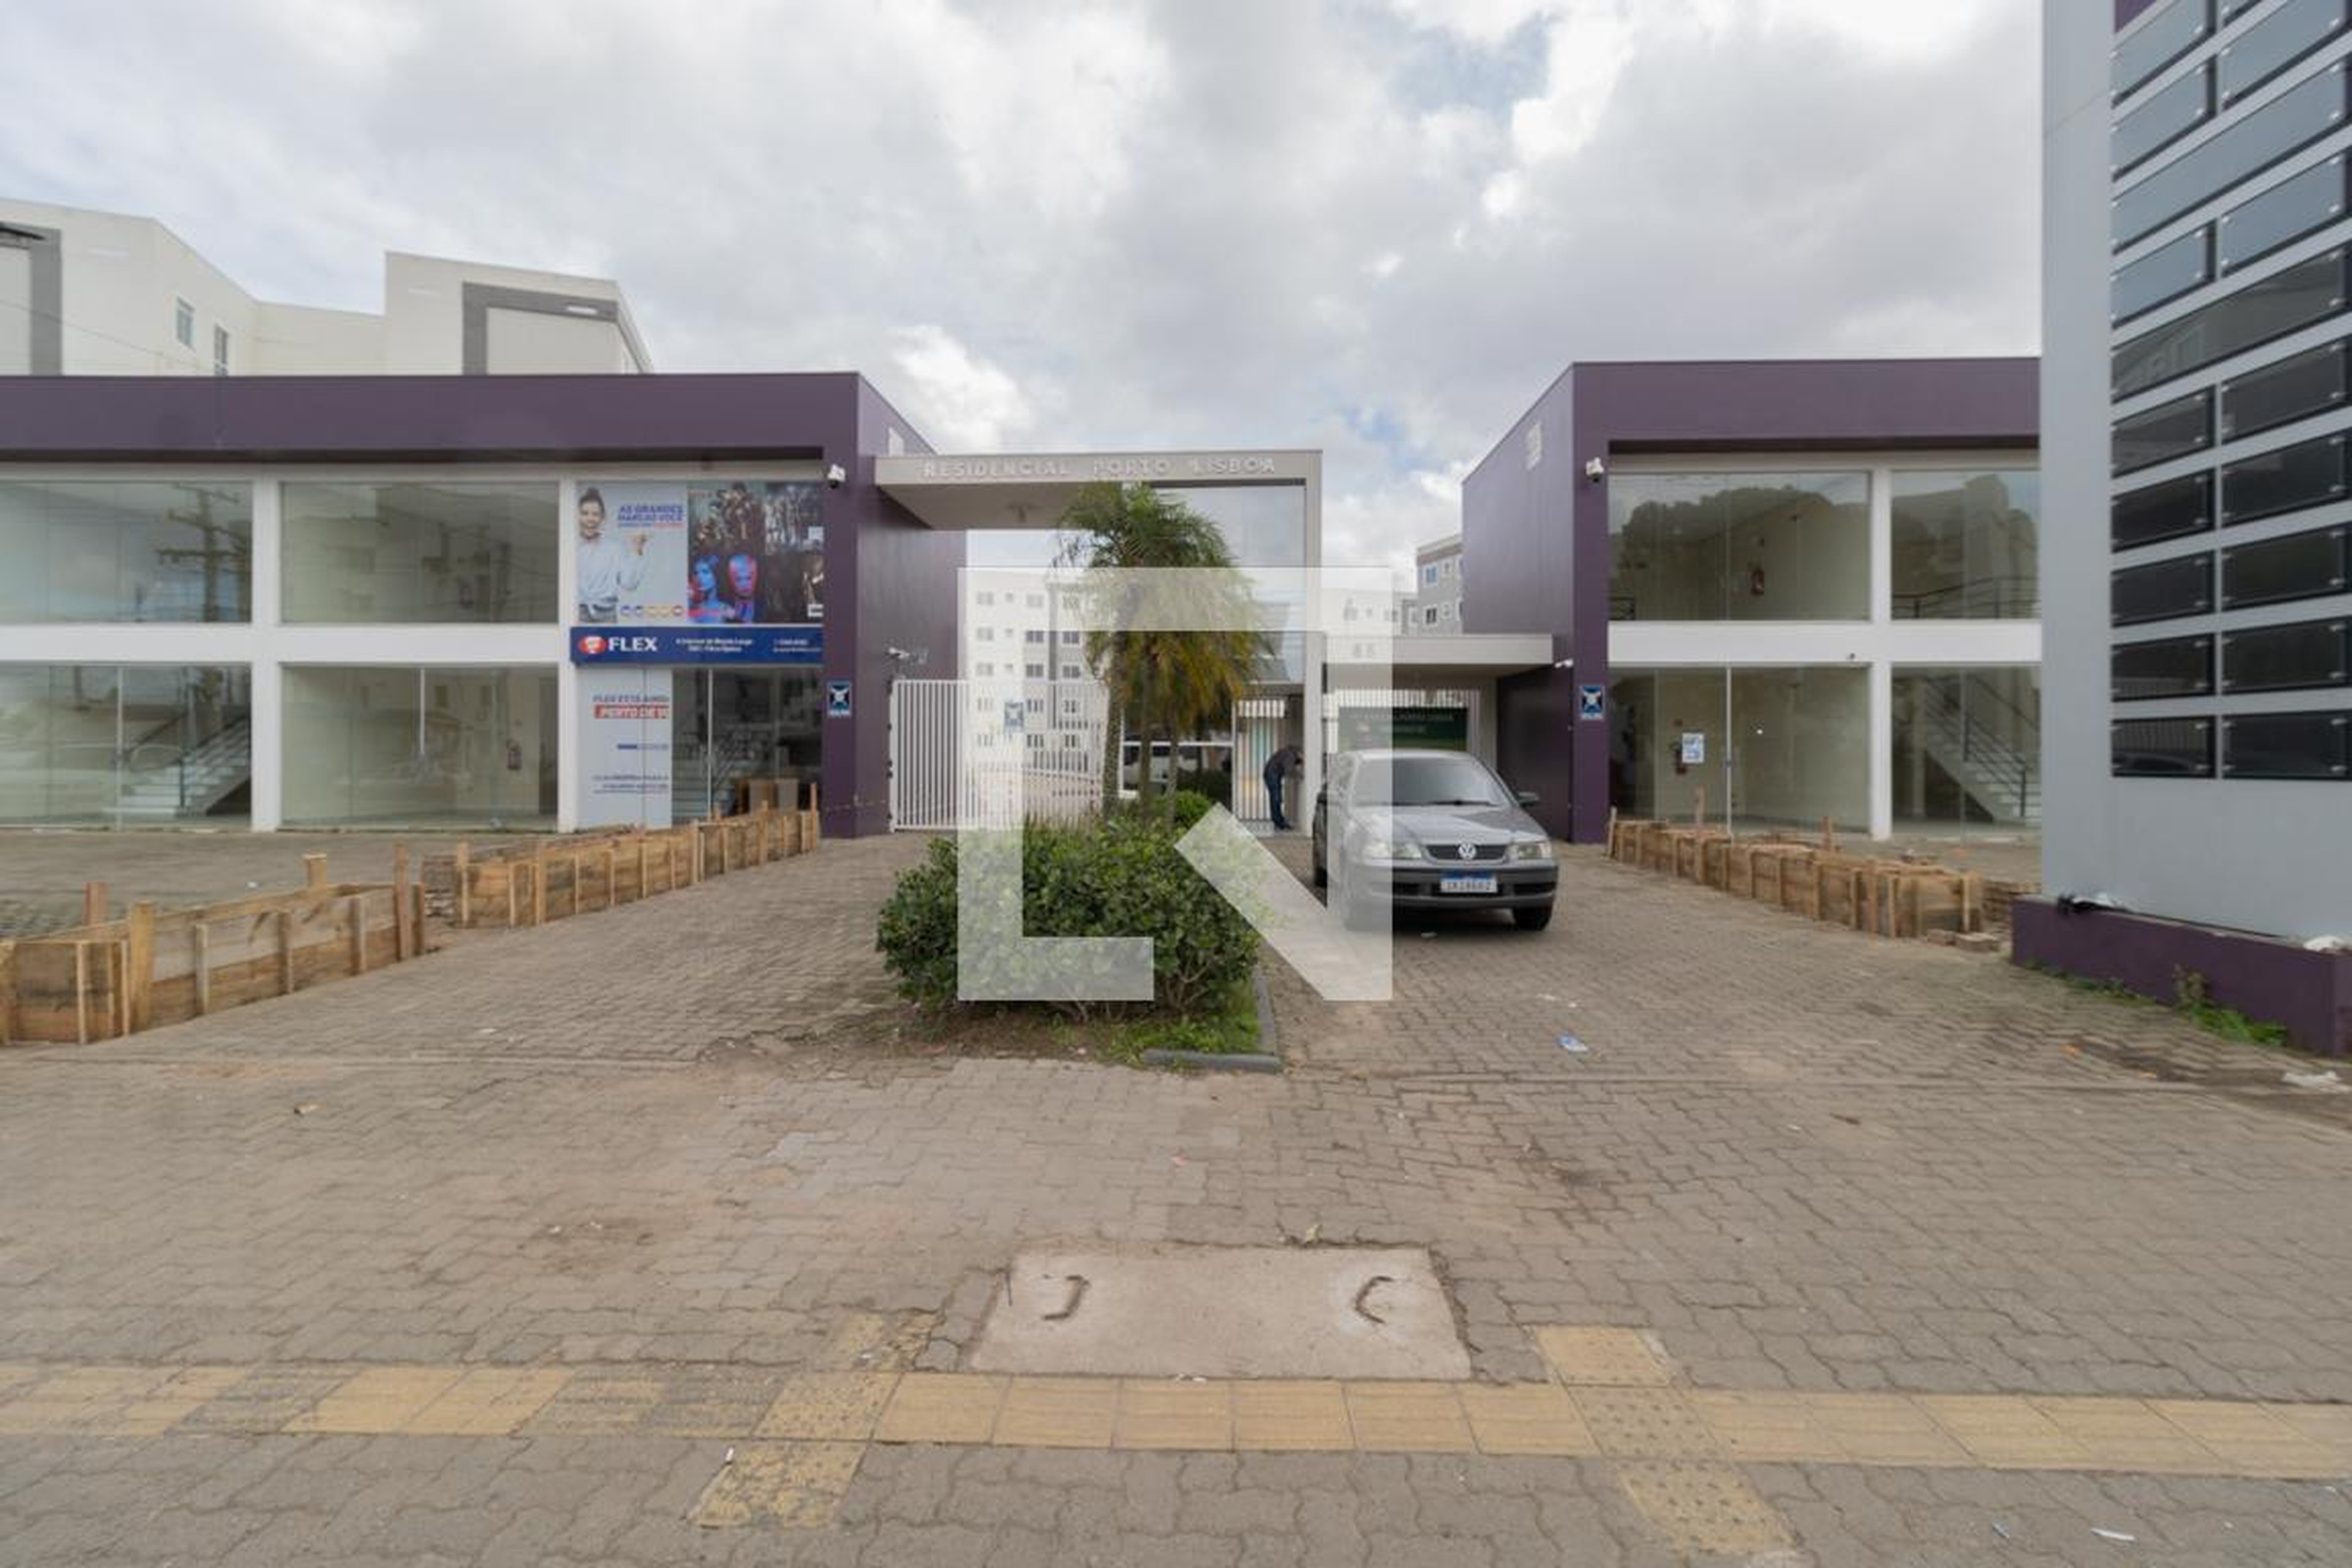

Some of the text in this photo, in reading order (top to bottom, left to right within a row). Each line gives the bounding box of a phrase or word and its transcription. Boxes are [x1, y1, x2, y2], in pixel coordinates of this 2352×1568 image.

[924, 458, 1275, 477] RESIDENCIAL PORTO LISBOA
[608, 636, 658, 652] FLEX
